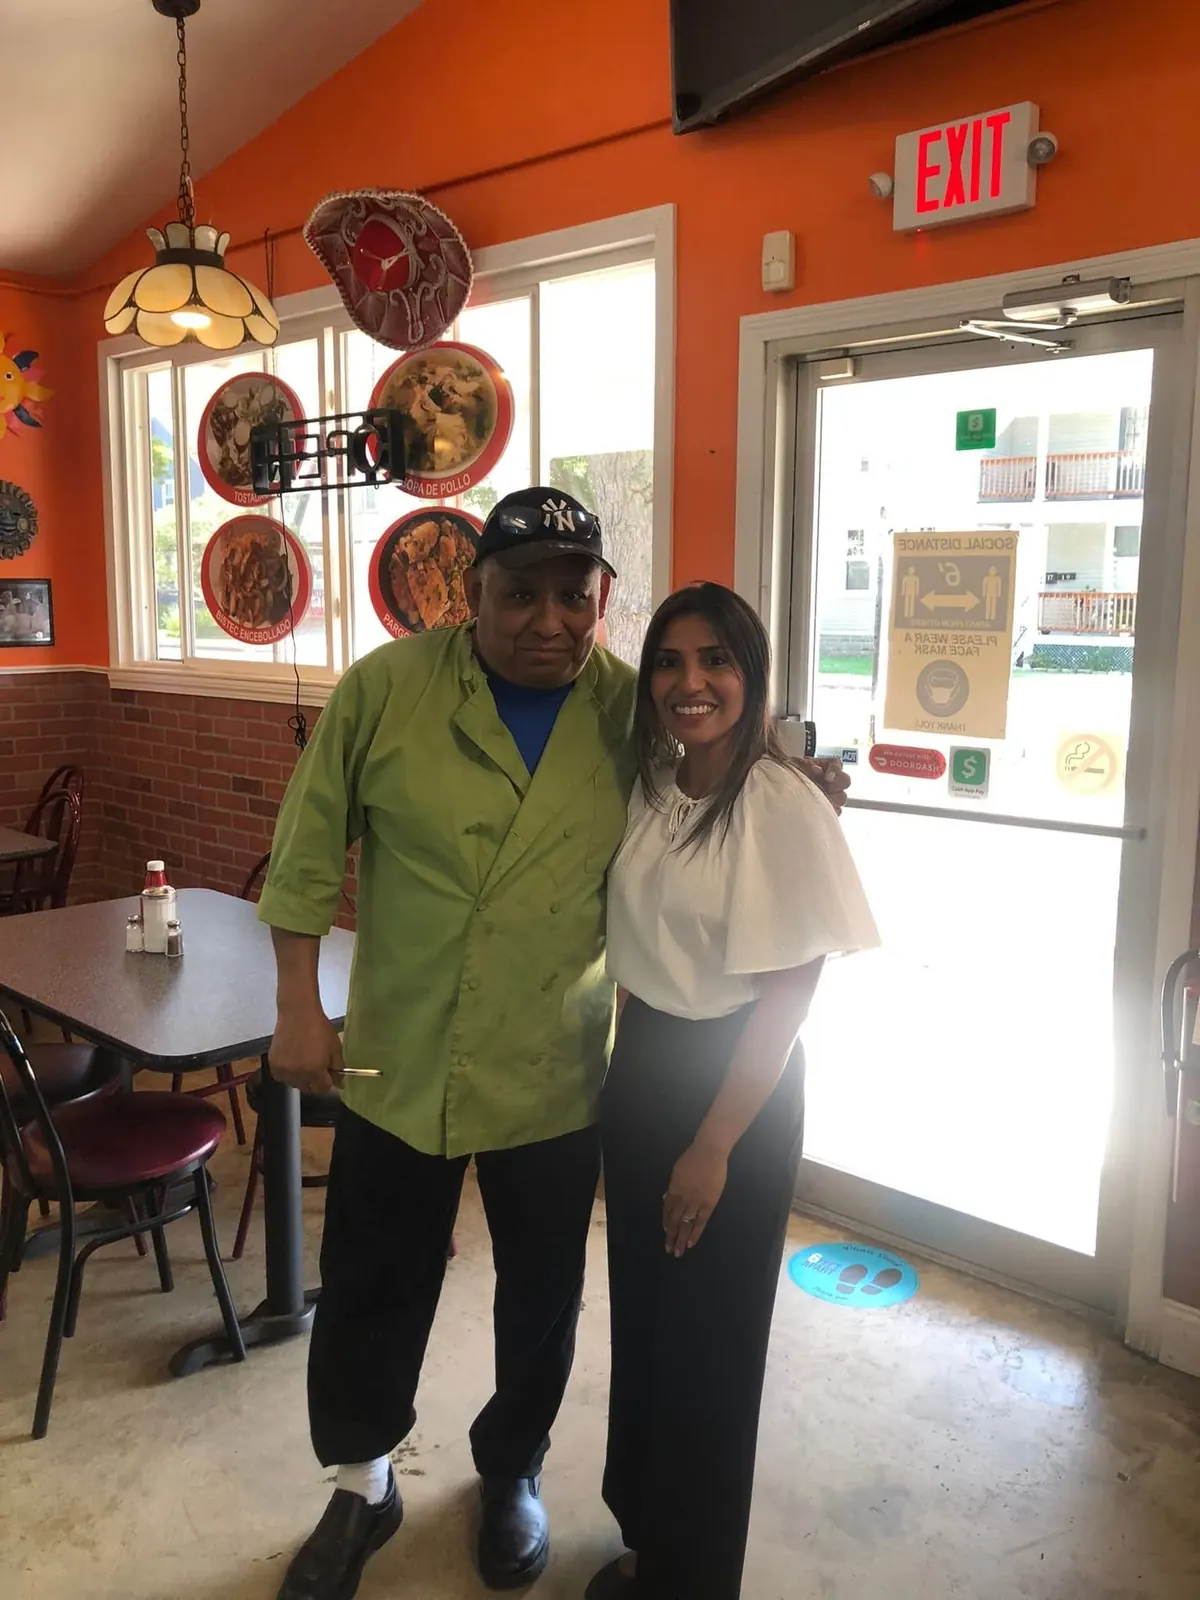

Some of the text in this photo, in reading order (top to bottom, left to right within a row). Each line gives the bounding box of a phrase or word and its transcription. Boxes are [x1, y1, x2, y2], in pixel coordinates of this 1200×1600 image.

[916, 112, 1011, 214] EXIT
[426, 483, 438, 495] DE
[440, 473, 471, 495] POLLO
[215, 609, 291, 642] BISTEC ENCEBOLLADO
[843, 751, 857, 761] ADT
